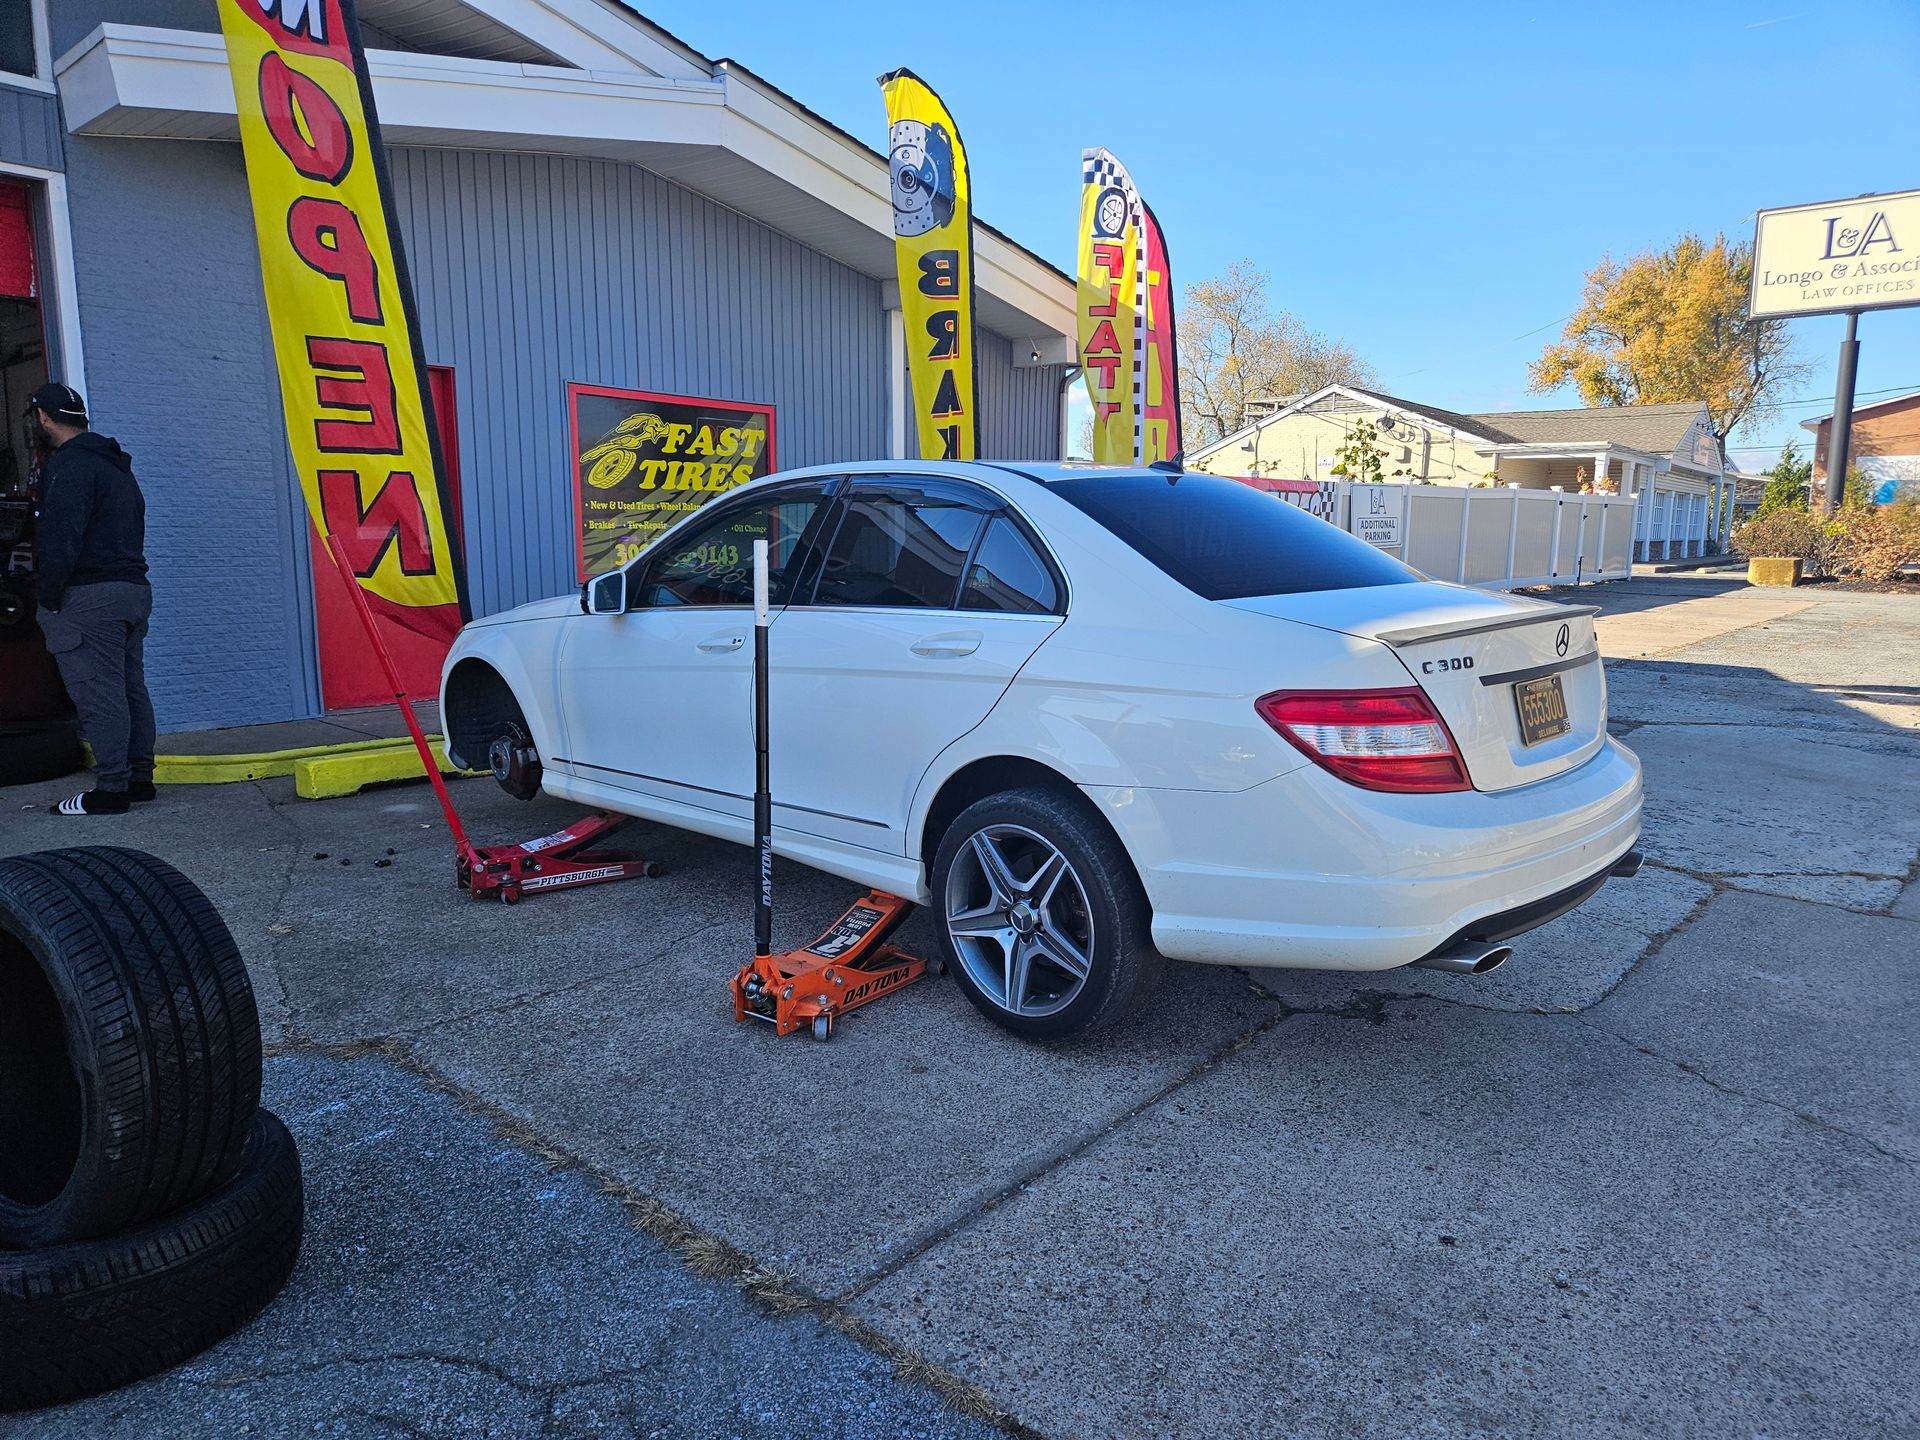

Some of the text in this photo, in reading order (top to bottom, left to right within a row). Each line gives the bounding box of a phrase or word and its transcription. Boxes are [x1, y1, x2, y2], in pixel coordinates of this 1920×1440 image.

[1763, 270, 1823, 288] Longo
[1830, 263, 1849, 280] &
[1802, 279, 1915, 300] LAW OFFICES
[661, 423, 766, 457] FAST
[638, 459, 754, 492] TIRES
[590, 501, 609, 510] New
[617, 501, 635, 510] Used
[637, 502, 655, 511] Tires
[660, 502, 681, 511] Wheel
[588, 521, 616, 529] Brakes
[1359, 519, 1396, 530] ADDITIONAL
[1364, 531, 1391, 541] PARKING
[614, 543, 649, 566] 30
[1522, 688, 1564, 727] 555300
[538, 868, 607, 887] PITTSBURGH
[762, 835, 772, 907] DAYTONA
[842, 966, 911, 1006] DAYTONA
